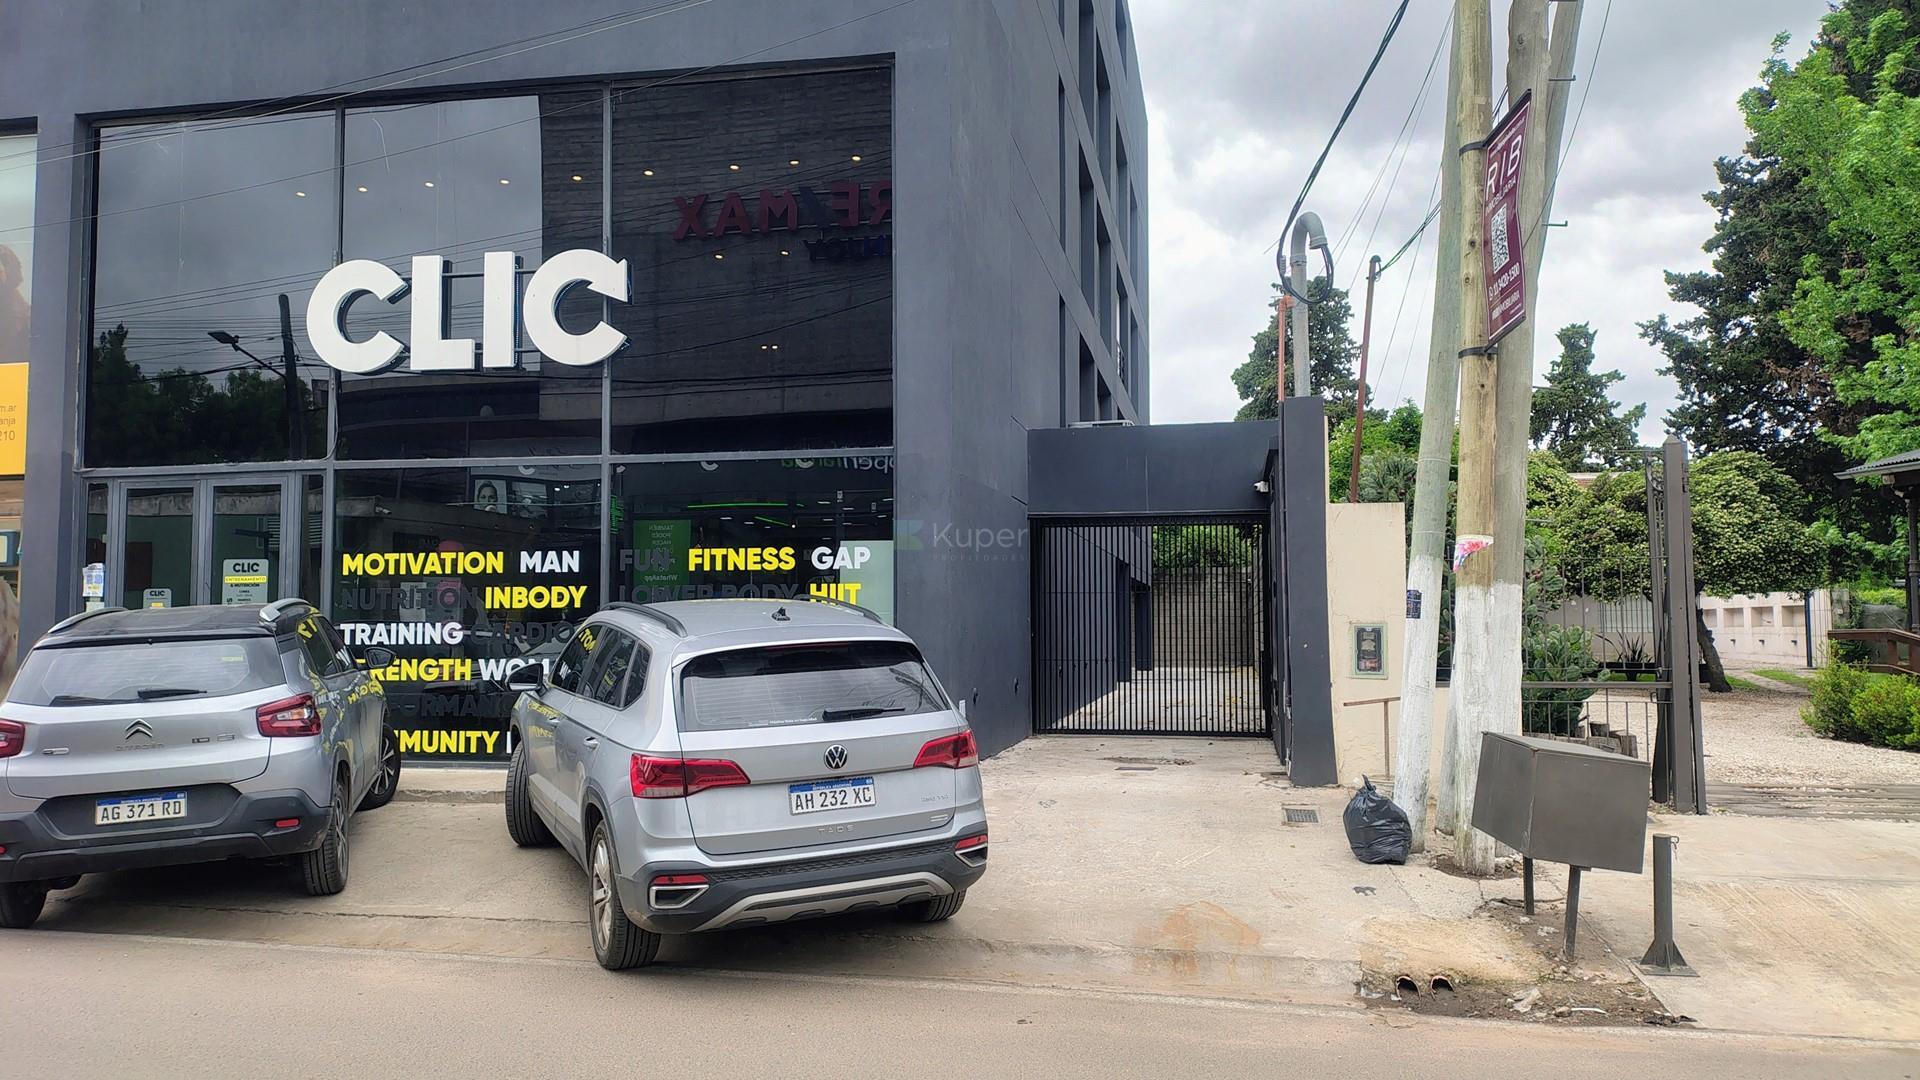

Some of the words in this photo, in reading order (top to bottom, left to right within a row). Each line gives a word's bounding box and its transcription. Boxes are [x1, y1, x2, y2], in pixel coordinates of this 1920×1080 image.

[1485, 134, 1523, 201] RIB
[306, 248, 632, 374] CLIC
[233, 562, 260, 573] CLIC
[342, 551, 504, 576] MOTIVATION
[519, 550, 580, 573] MAN
[619, 548, 673, 572] FUN
[688, 546, 796, 571] FITNESS
[811, 546, 871, 570] GAP
[341, 586, 479, 611] NUTRITION
[484, 585, 588, 609] INBODY
[809, 582, 862, 606] HIIT
[340, 621, 464, 646] TRAINING
[101, 805, 120, 822] AG
[126, 802, 156, 819] 371
[162, 800, 182, 816] RD
[795, 793, 815, 811] AH
[819, 789, 848, 808] 232
[853, 786, 872, 804] XC
